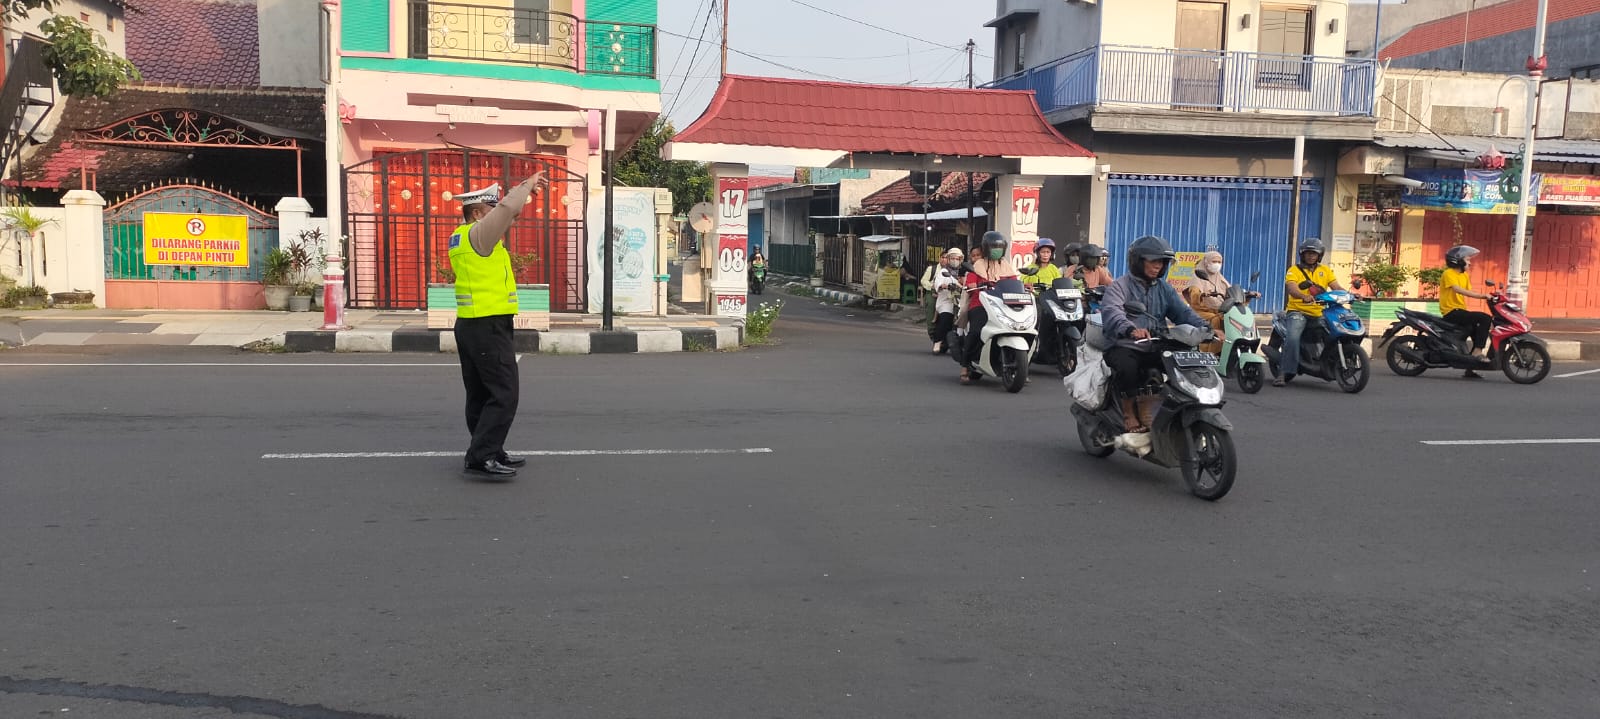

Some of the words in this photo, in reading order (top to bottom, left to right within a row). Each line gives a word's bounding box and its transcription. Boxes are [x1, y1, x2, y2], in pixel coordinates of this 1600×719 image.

[721, 189, 745, 218] 17
[1014, 197, 1036, 226] 17
[151, 238, 201, 249] DILARANG
[203, 239, 240, 250] PARKIR
[158, 251, 168, 261] DI
[171, 251, 203, 261] DEPAN
[205, 252, 235, 262] PINTU
[720, 247, 745, 272] 08
[1179, 254, 1200, 262] STOP
[720, 298, 742, 311] 1945
